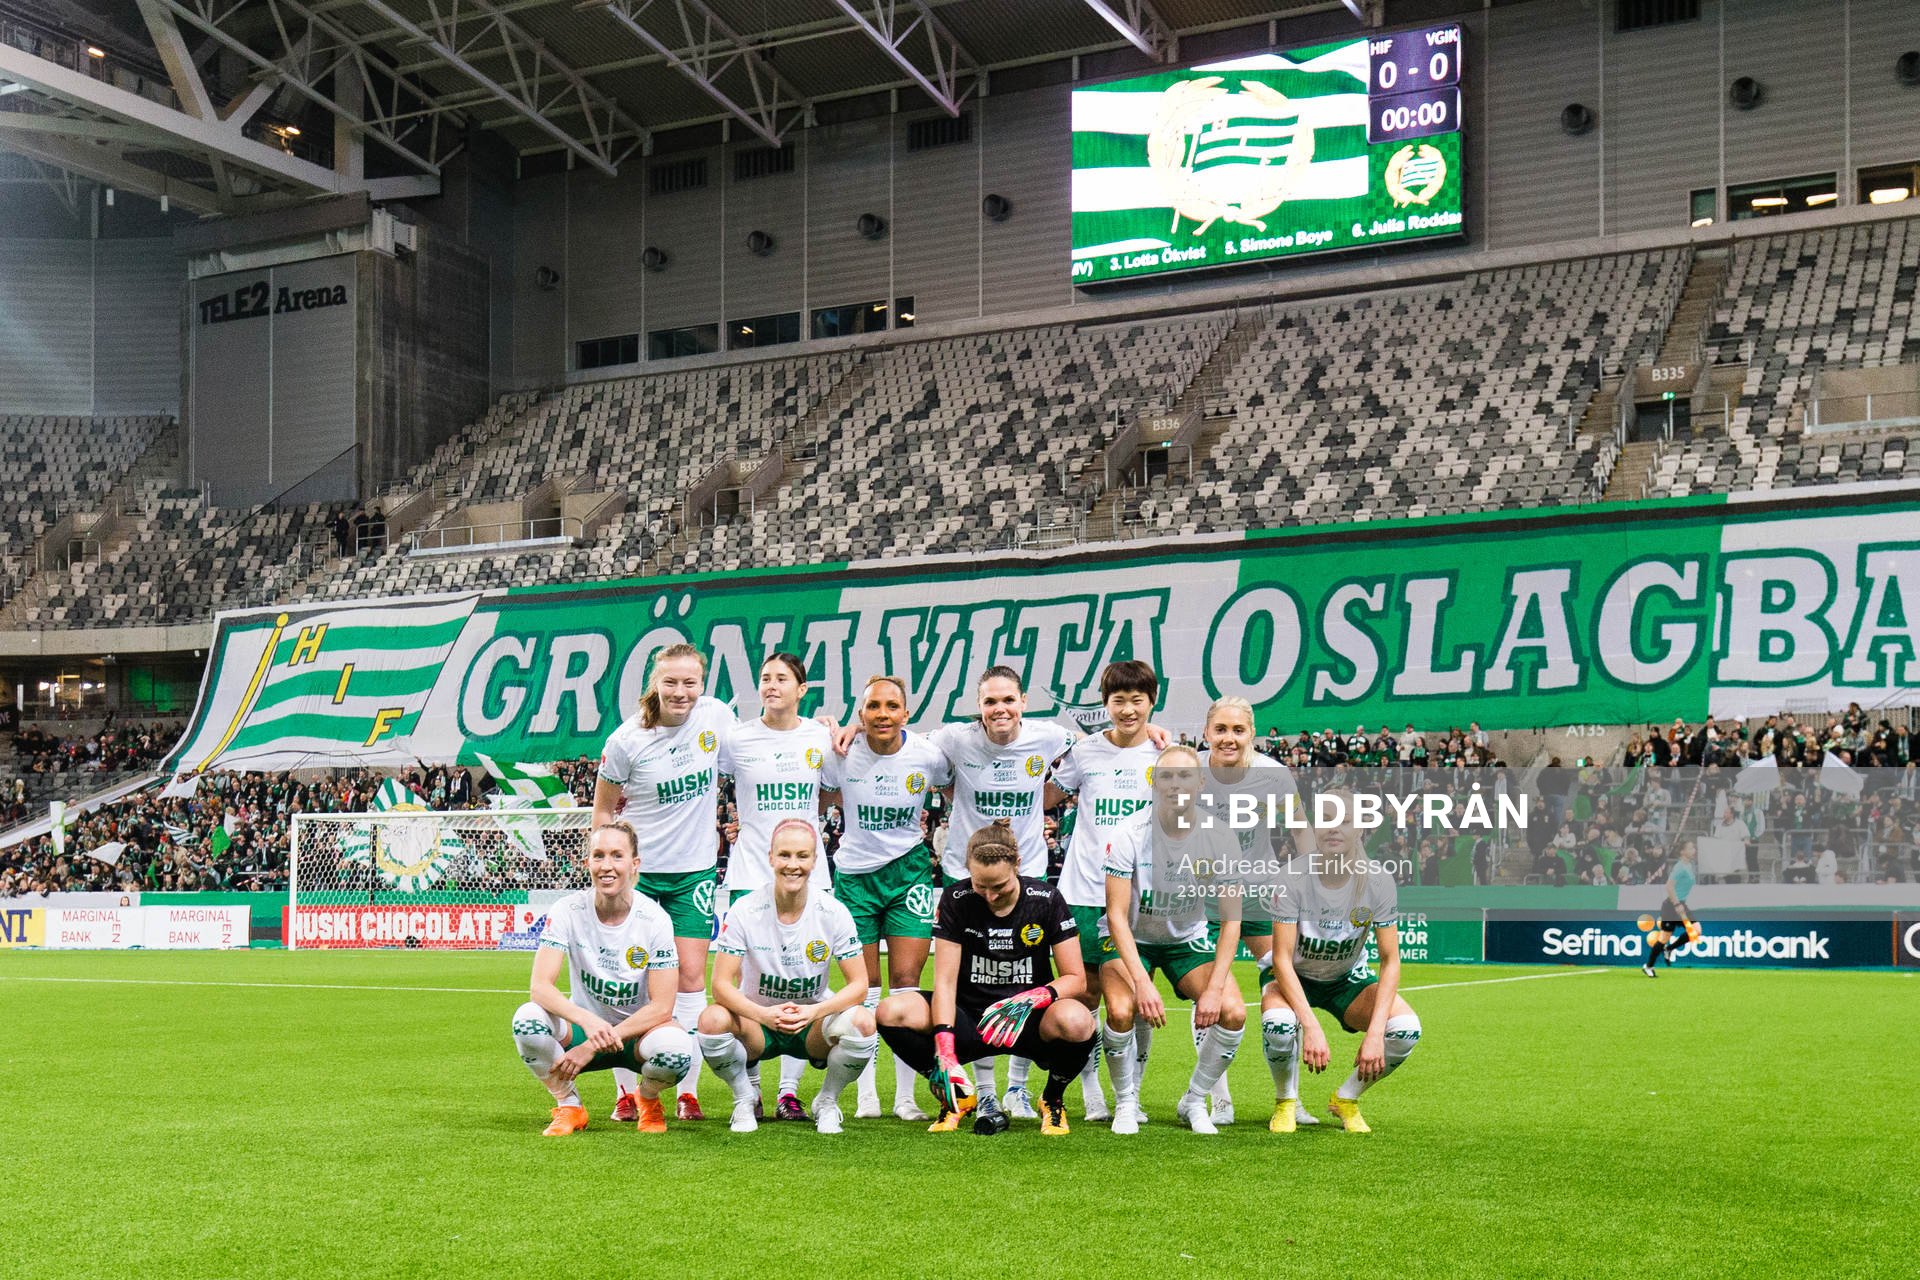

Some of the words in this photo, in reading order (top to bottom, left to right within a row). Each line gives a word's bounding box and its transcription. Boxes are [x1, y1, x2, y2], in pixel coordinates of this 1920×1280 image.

[1426, 28, 1457, 46] VGIK
[1370, 39, 1393, 56] HIF
[1379, 61, 1397, 88] 0
[1430, 52, 1448, 80] 0
[1381, 101, 1446, 131] 00:00
[1110, 257, 1122, 271] 3.
[1124, 252, 1158, 269] Lotta
[1161, 245, 1206, 264] Ökvist
[1225, 240, 1238, 255] 5.
[1240, 235, 1294, 253] Simone
[1295, 230, 1333, 246] Boye
[1369, 217, 1406, 236] Julia
[199, 281, 271, 325] TELE2
[274, 284, 348, 314] Arena
[1652, 366, 1685, 381] B335
[1153, 418, 1181, 431] B336
[656, 767, 713, 798] HUSKI
[756, 783, 814, 801] HUSKI
[974, 790, 1035, 808] HUSKI
[757, 801, 811, 811] CHOCOLATE
[857, 804, 915, 822] HUSKI
[361, 911, 508, 941] CHOCOLATE
[61, 931, 91, 943] BANK
[169, 931, 201, 943] BANK
[1297, 934, 1358, 955] HUSKI
[1543, 927, 1642, 956] Sefina
[1670, 930, 1829, 962] pantbank
[971, 955, 1033, 976] HUSKI
[580, 968, 639, 999] HUSKI
[760, 973, 822, 993] HUSKI
[970, 973, 1034, 985] CHOCOLATE
[758, 988, 820, 1000] CHOCOLATE
